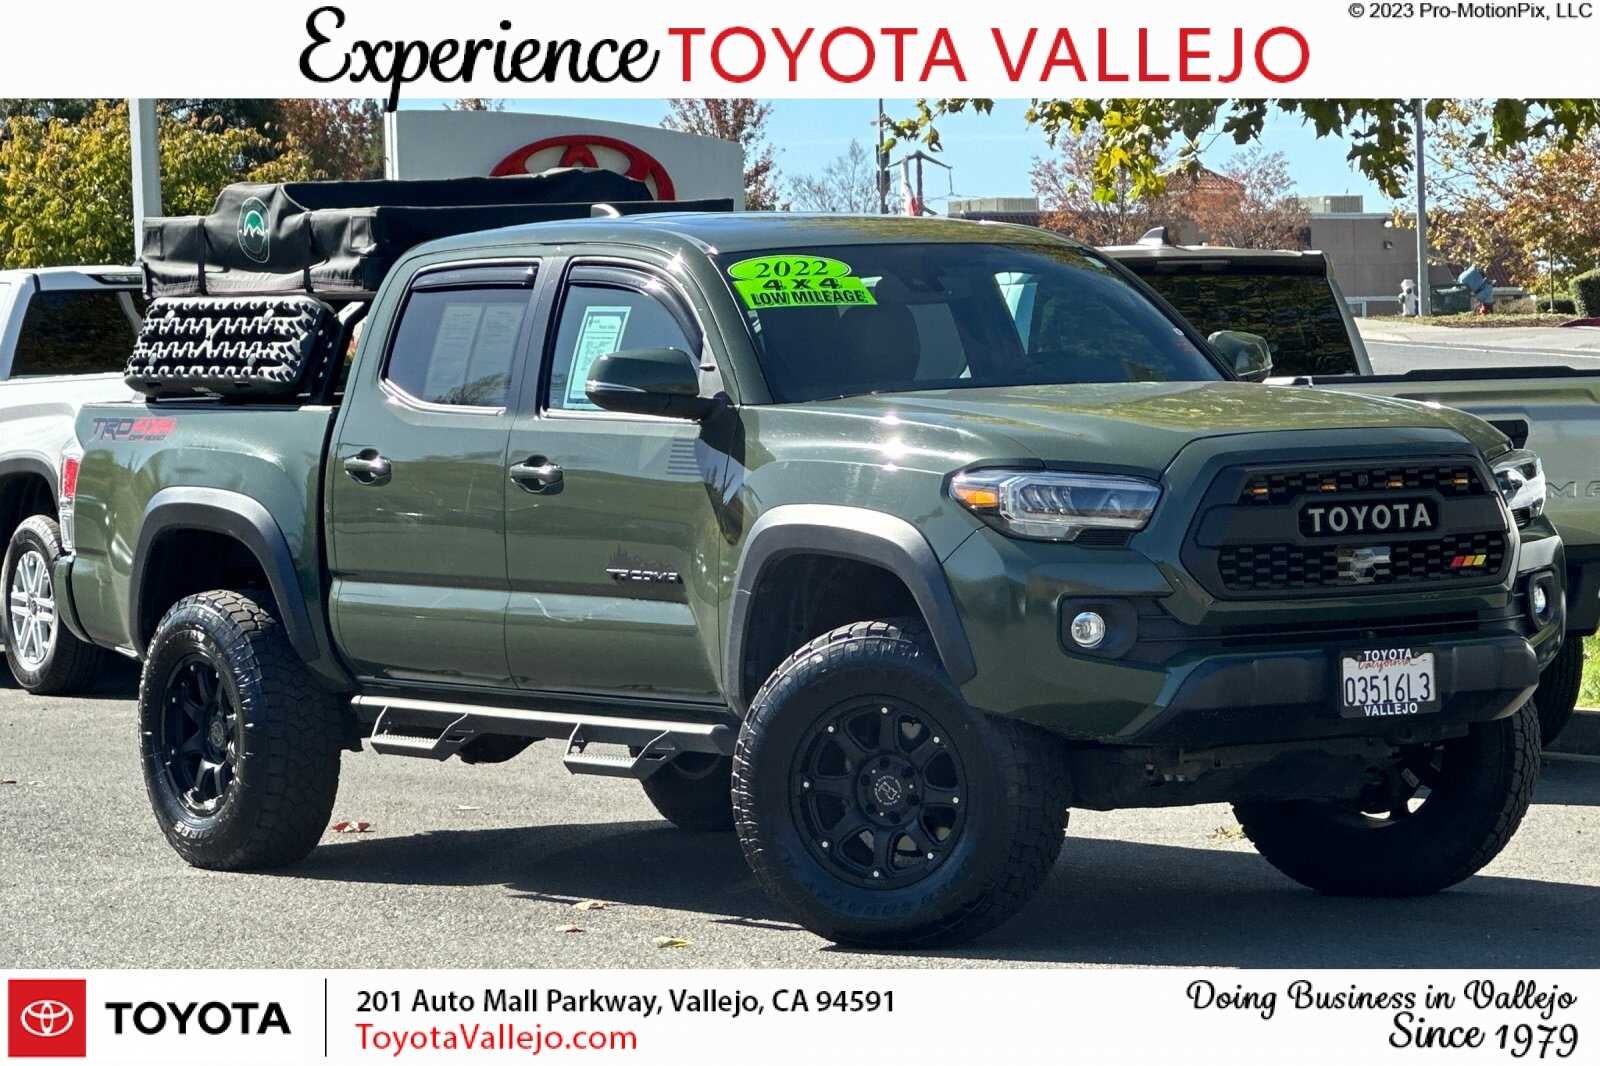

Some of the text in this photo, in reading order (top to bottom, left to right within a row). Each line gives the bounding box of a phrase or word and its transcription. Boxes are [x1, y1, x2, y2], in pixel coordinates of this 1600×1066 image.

[755, 261, 830, 278] 2022
[751, 290, 868, 306] LOW MILEAGE
[93, 417, 135, 440] TRD
[1308, 502, 1432, 532] TOYOTA
[1363, 647, 1412, 662] TOYOTA
[1344, 671, 1431, 706] 03516L3
[1363, 702, 1418, 717] VALLEJO
